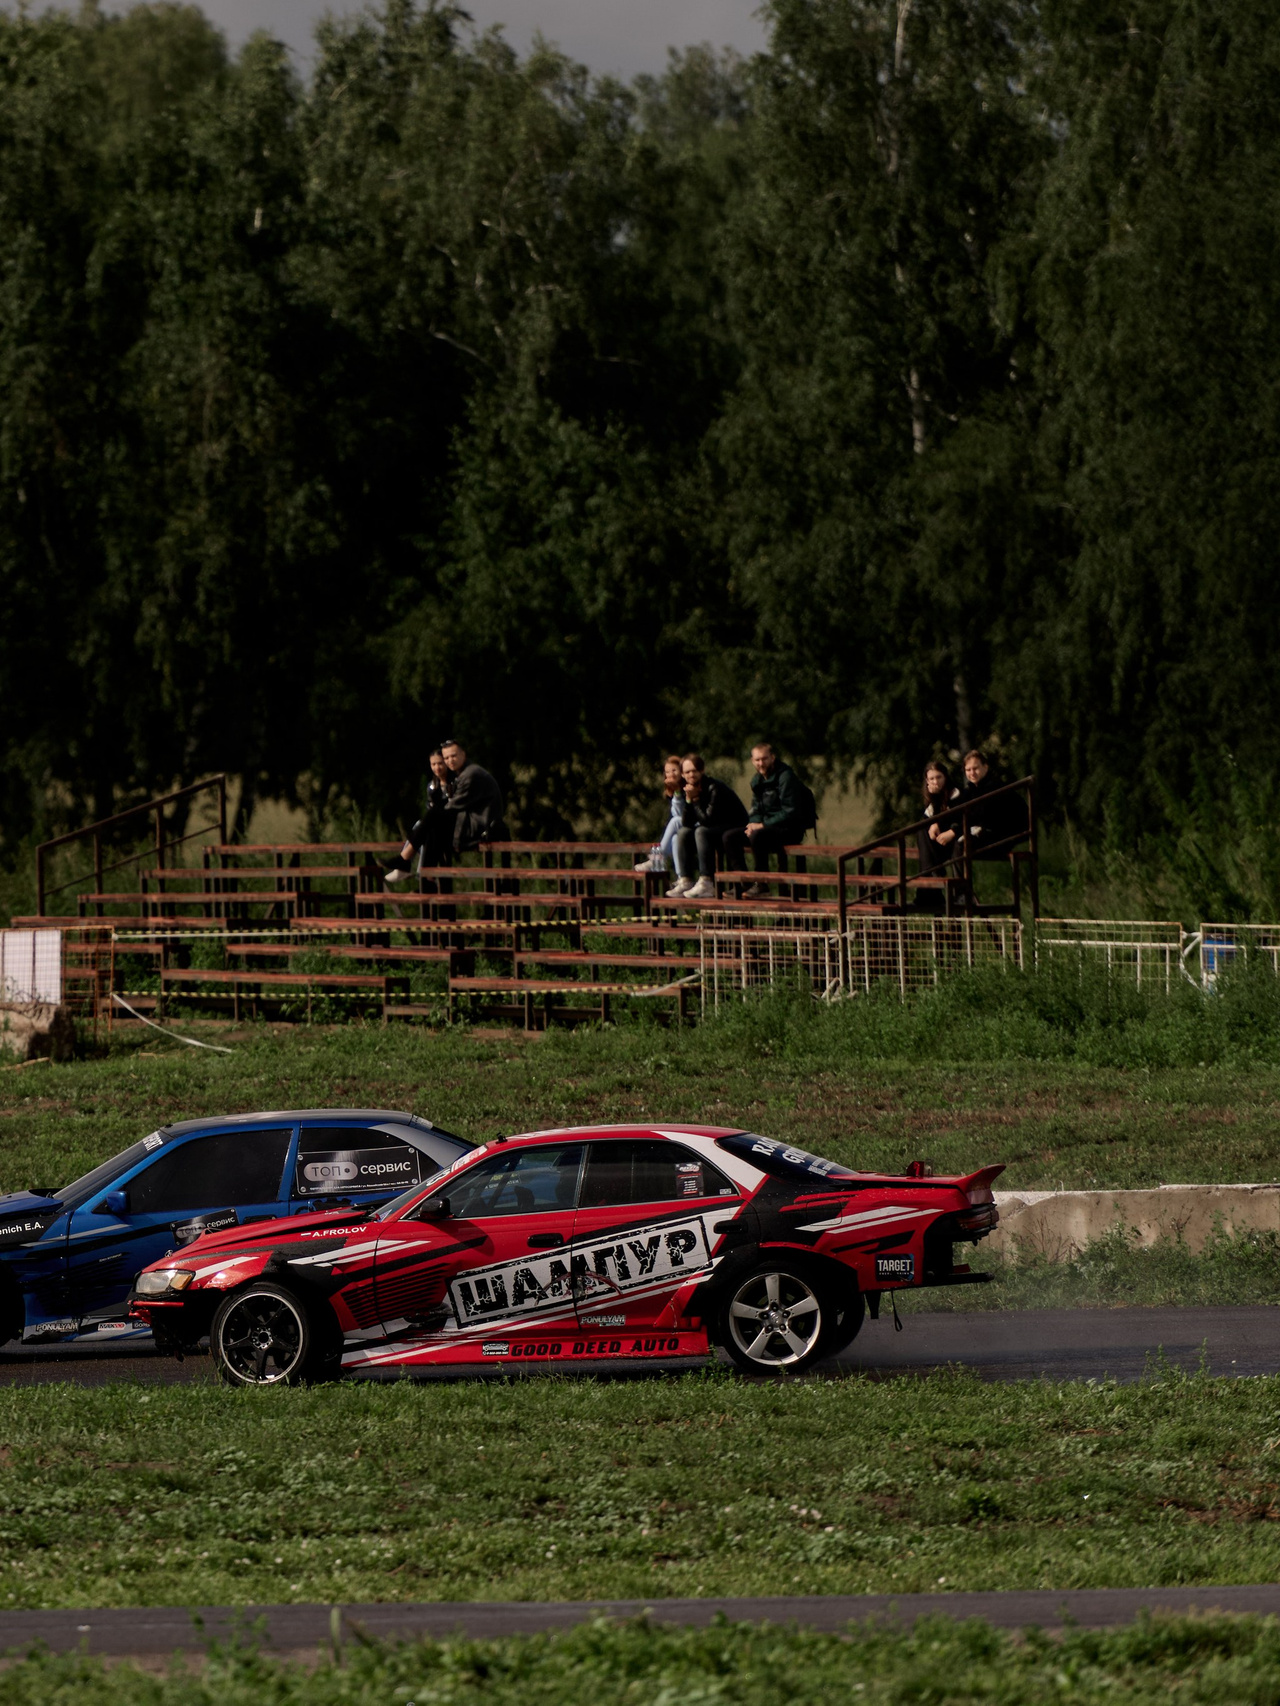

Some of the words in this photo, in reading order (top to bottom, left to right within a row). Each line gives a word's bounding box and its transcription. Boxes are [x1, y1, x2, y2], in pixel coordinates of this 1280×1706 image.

[311, 1165, 341, 1177] ТОП
[360, 1161, 412, 1176] сервис
[24, 1221, 44, 1231] E.A.
[312, 1226, 367, 1238] A.FROLOV
[877, 1259, 912, 1272] TARGET
[457, 1229, 697, 1318] ШАМПУР
[510, 1343, 563, 1357] GOOD
[571, 1341, 622, 1355] DEED
[630, 1338, 679, 1353] AUTO
